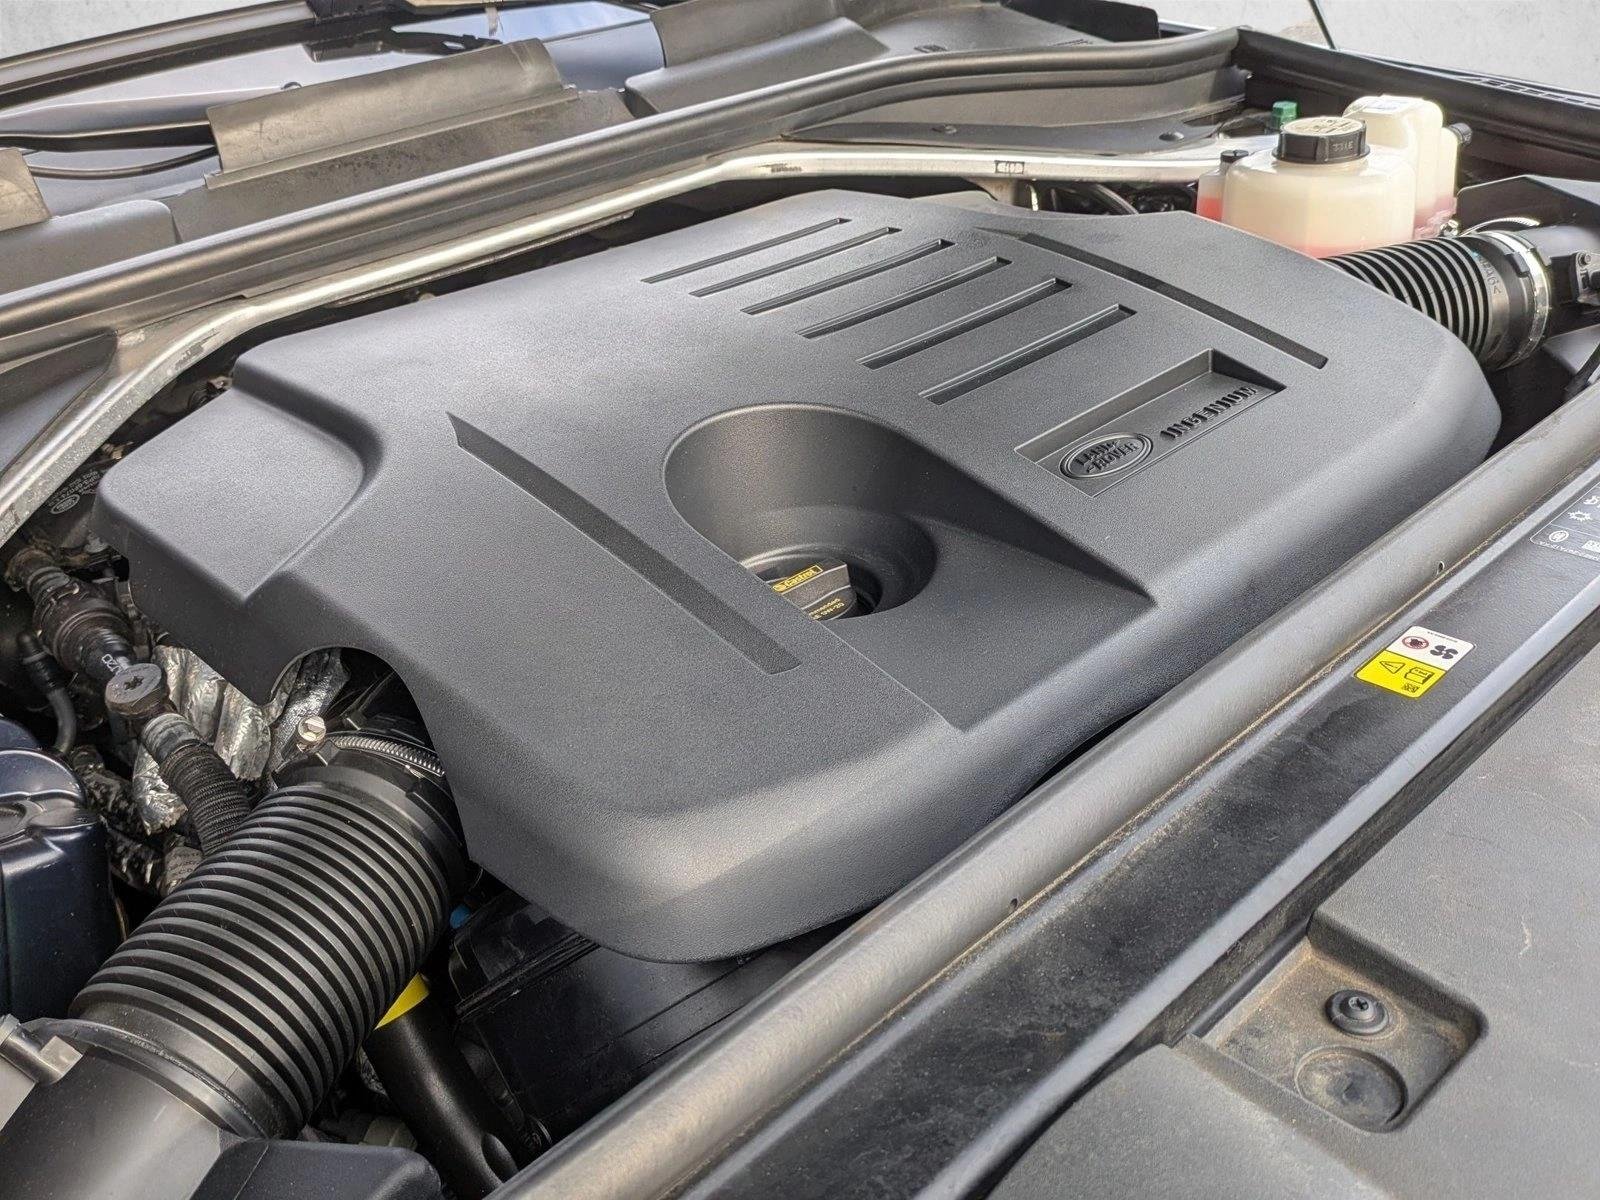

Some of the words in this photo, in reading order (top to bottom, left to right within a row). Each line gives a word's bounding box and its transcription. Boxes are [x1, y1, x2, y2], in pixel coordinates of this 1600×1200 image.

[1160, 386, 1256, 440] INGENIUM
[1074, 440, 1119, 467] LAND
[1086, 442, 1139, 473] ROVER
